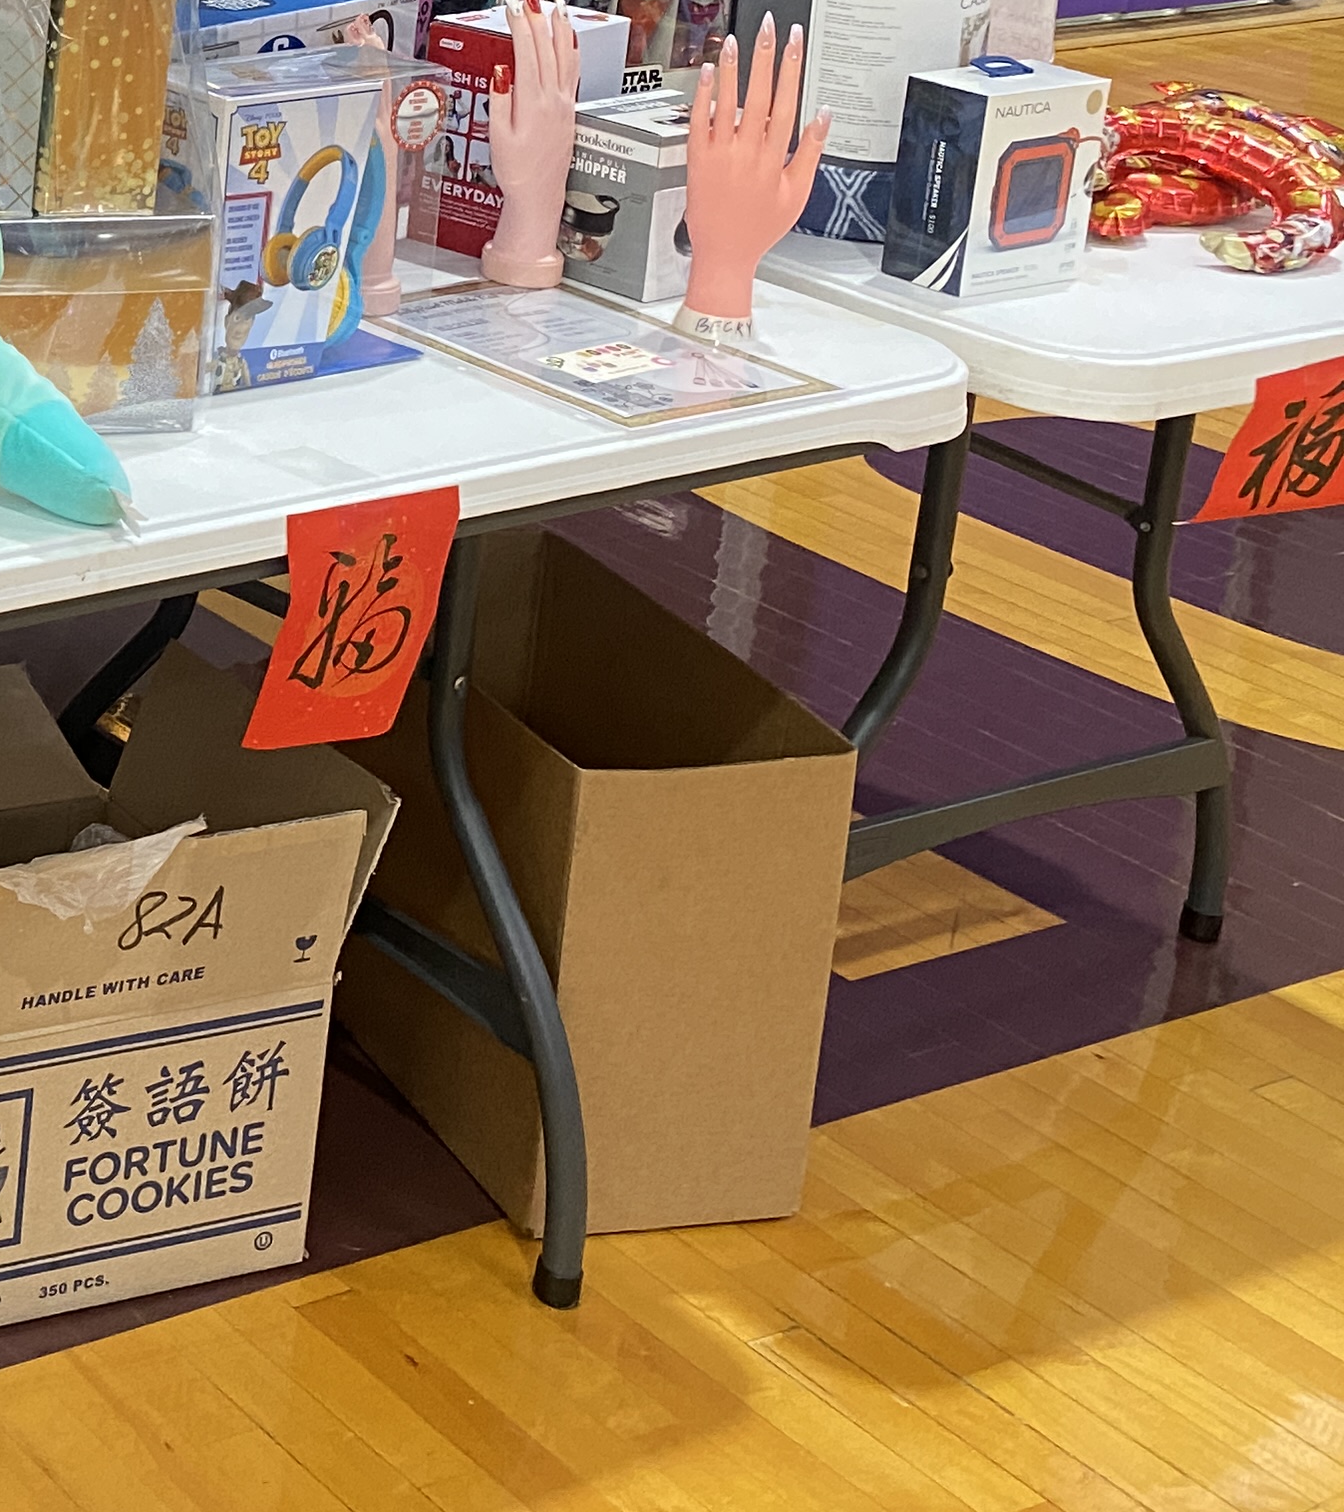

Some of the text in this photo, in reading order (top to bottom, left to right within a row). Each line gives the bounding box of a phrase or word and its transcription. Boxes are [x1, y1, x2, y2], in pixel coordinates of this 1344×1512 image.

[474, 74, 489, 88] IS
[995, 100, 1052, 120] NAUTICA
[241, 120, 287, 150] TOY
[575, 131, 634, 157] rookstone
[243, 147, 281, 161] STORY
[935, 141, 947, 174] NAUTICA
[248, 160, 270, 185] 4
[570, 156, 628, 185] CHOPPER
[421, 175, 505, 209] EVERYDAY
[930, 174, 942, 210] SPEAKER
[695, 316, 754, 336] BECKY
[290, 534, 411, 690] 福
[117, 885, 225, 951] 82A
[20, 966, 206, 1011] HANDLE WITH CARE
[63, 1121, 265, 1193] FORTUNE
[66, 1161, 254, 1226] COOKIES
[39, 1273, 110, 1299] 350 PCS.
